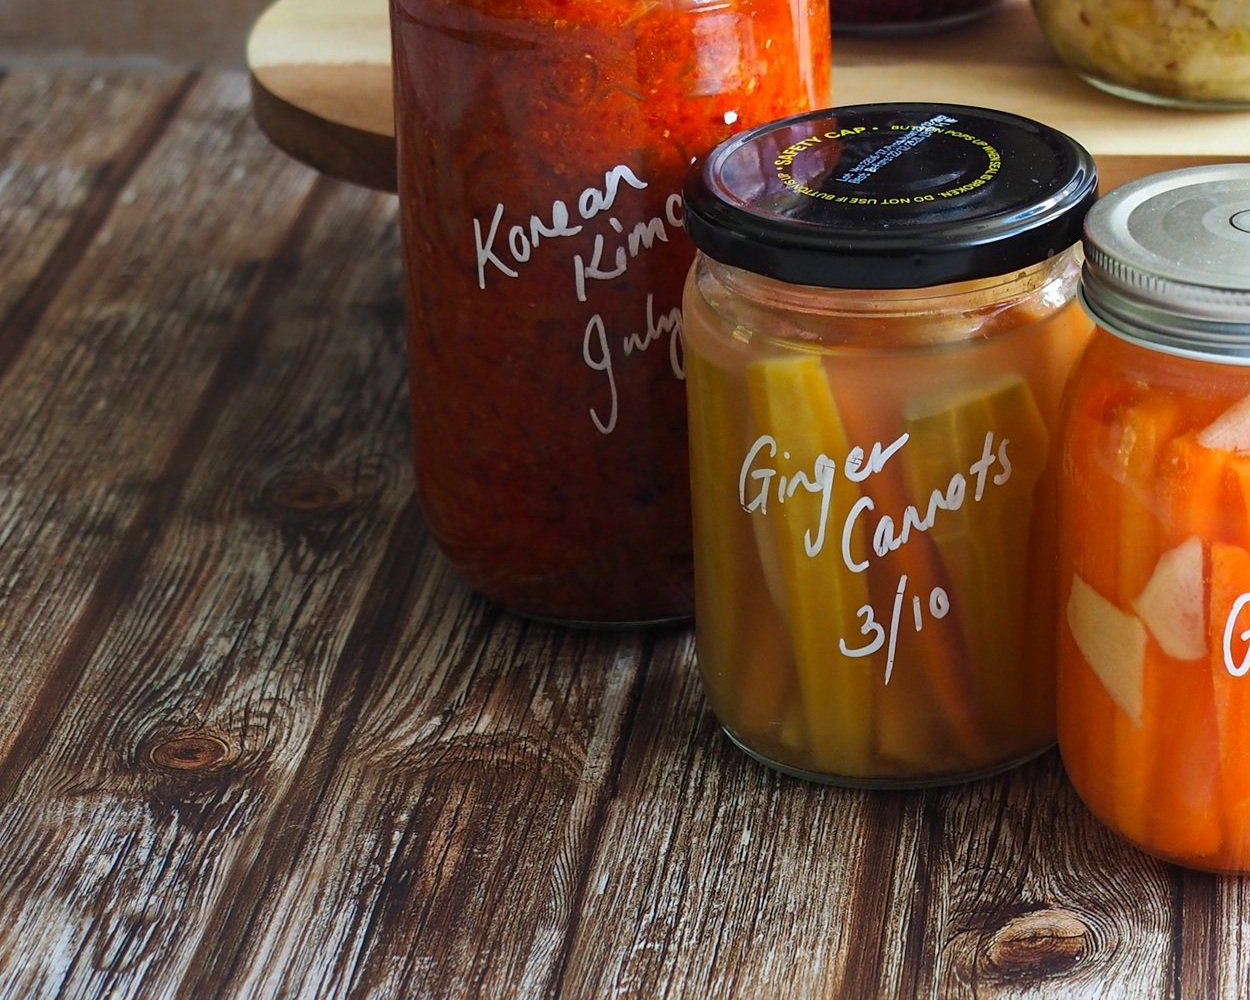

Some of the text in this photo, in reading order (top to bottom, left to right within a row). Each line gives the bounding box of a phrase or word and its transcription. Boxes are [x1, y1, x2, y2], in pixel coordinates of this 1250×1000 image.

[774, 126, 865, 166] SAFETY CAP
[891, 125, 945, 135] BUTN
[473, 164, 648, 289] Korean
[573, 193, 684, 301] Kimc
[739, 432, 910, 557] Ginger
[842, 431, 1012, 573] Carrots
[839, 574, 950, 686] 3/10
